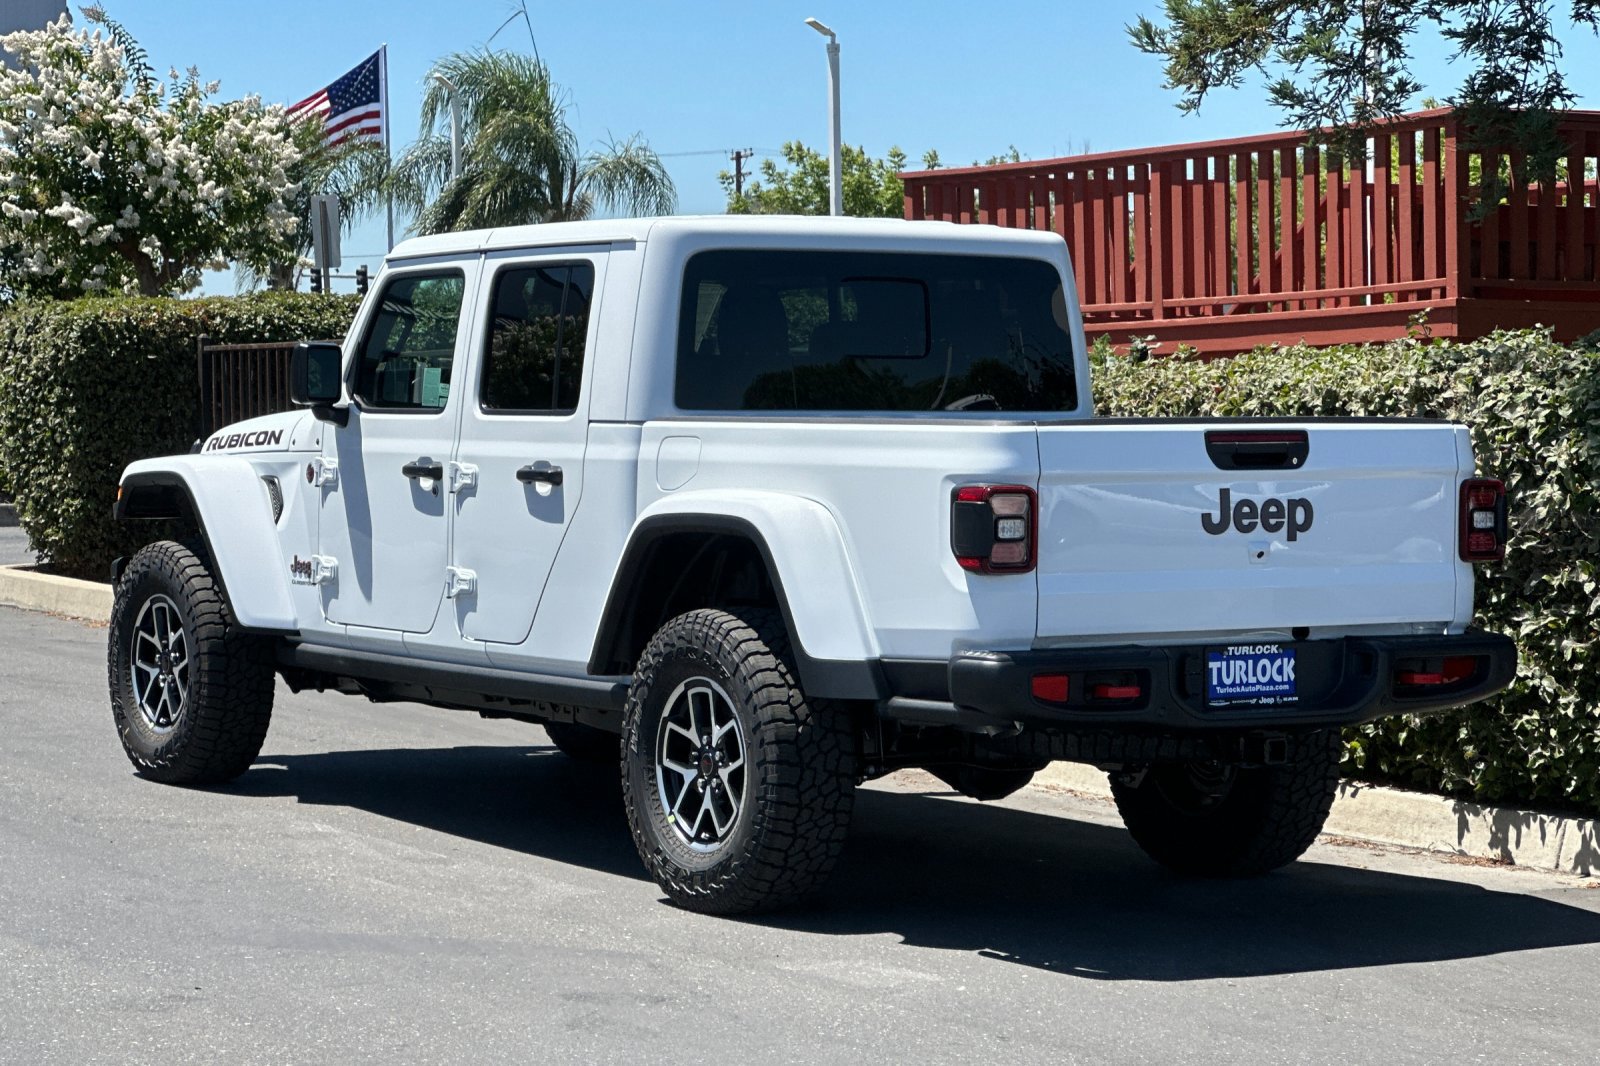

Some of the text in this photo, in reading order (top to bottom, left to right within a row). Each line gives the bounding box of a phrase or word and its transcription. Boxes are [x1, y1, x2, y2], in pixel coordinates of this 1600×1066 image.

[206, 429, 284, 452] RUBICON
[1201, 488, 1314, 541] Jeep
[1227, 644, 1279, 656] TURLOCK
[1209, 657, 1295, 685] TURLOCK
[1216, 684, 1290, 694] TurlockAutoPlaza.com
